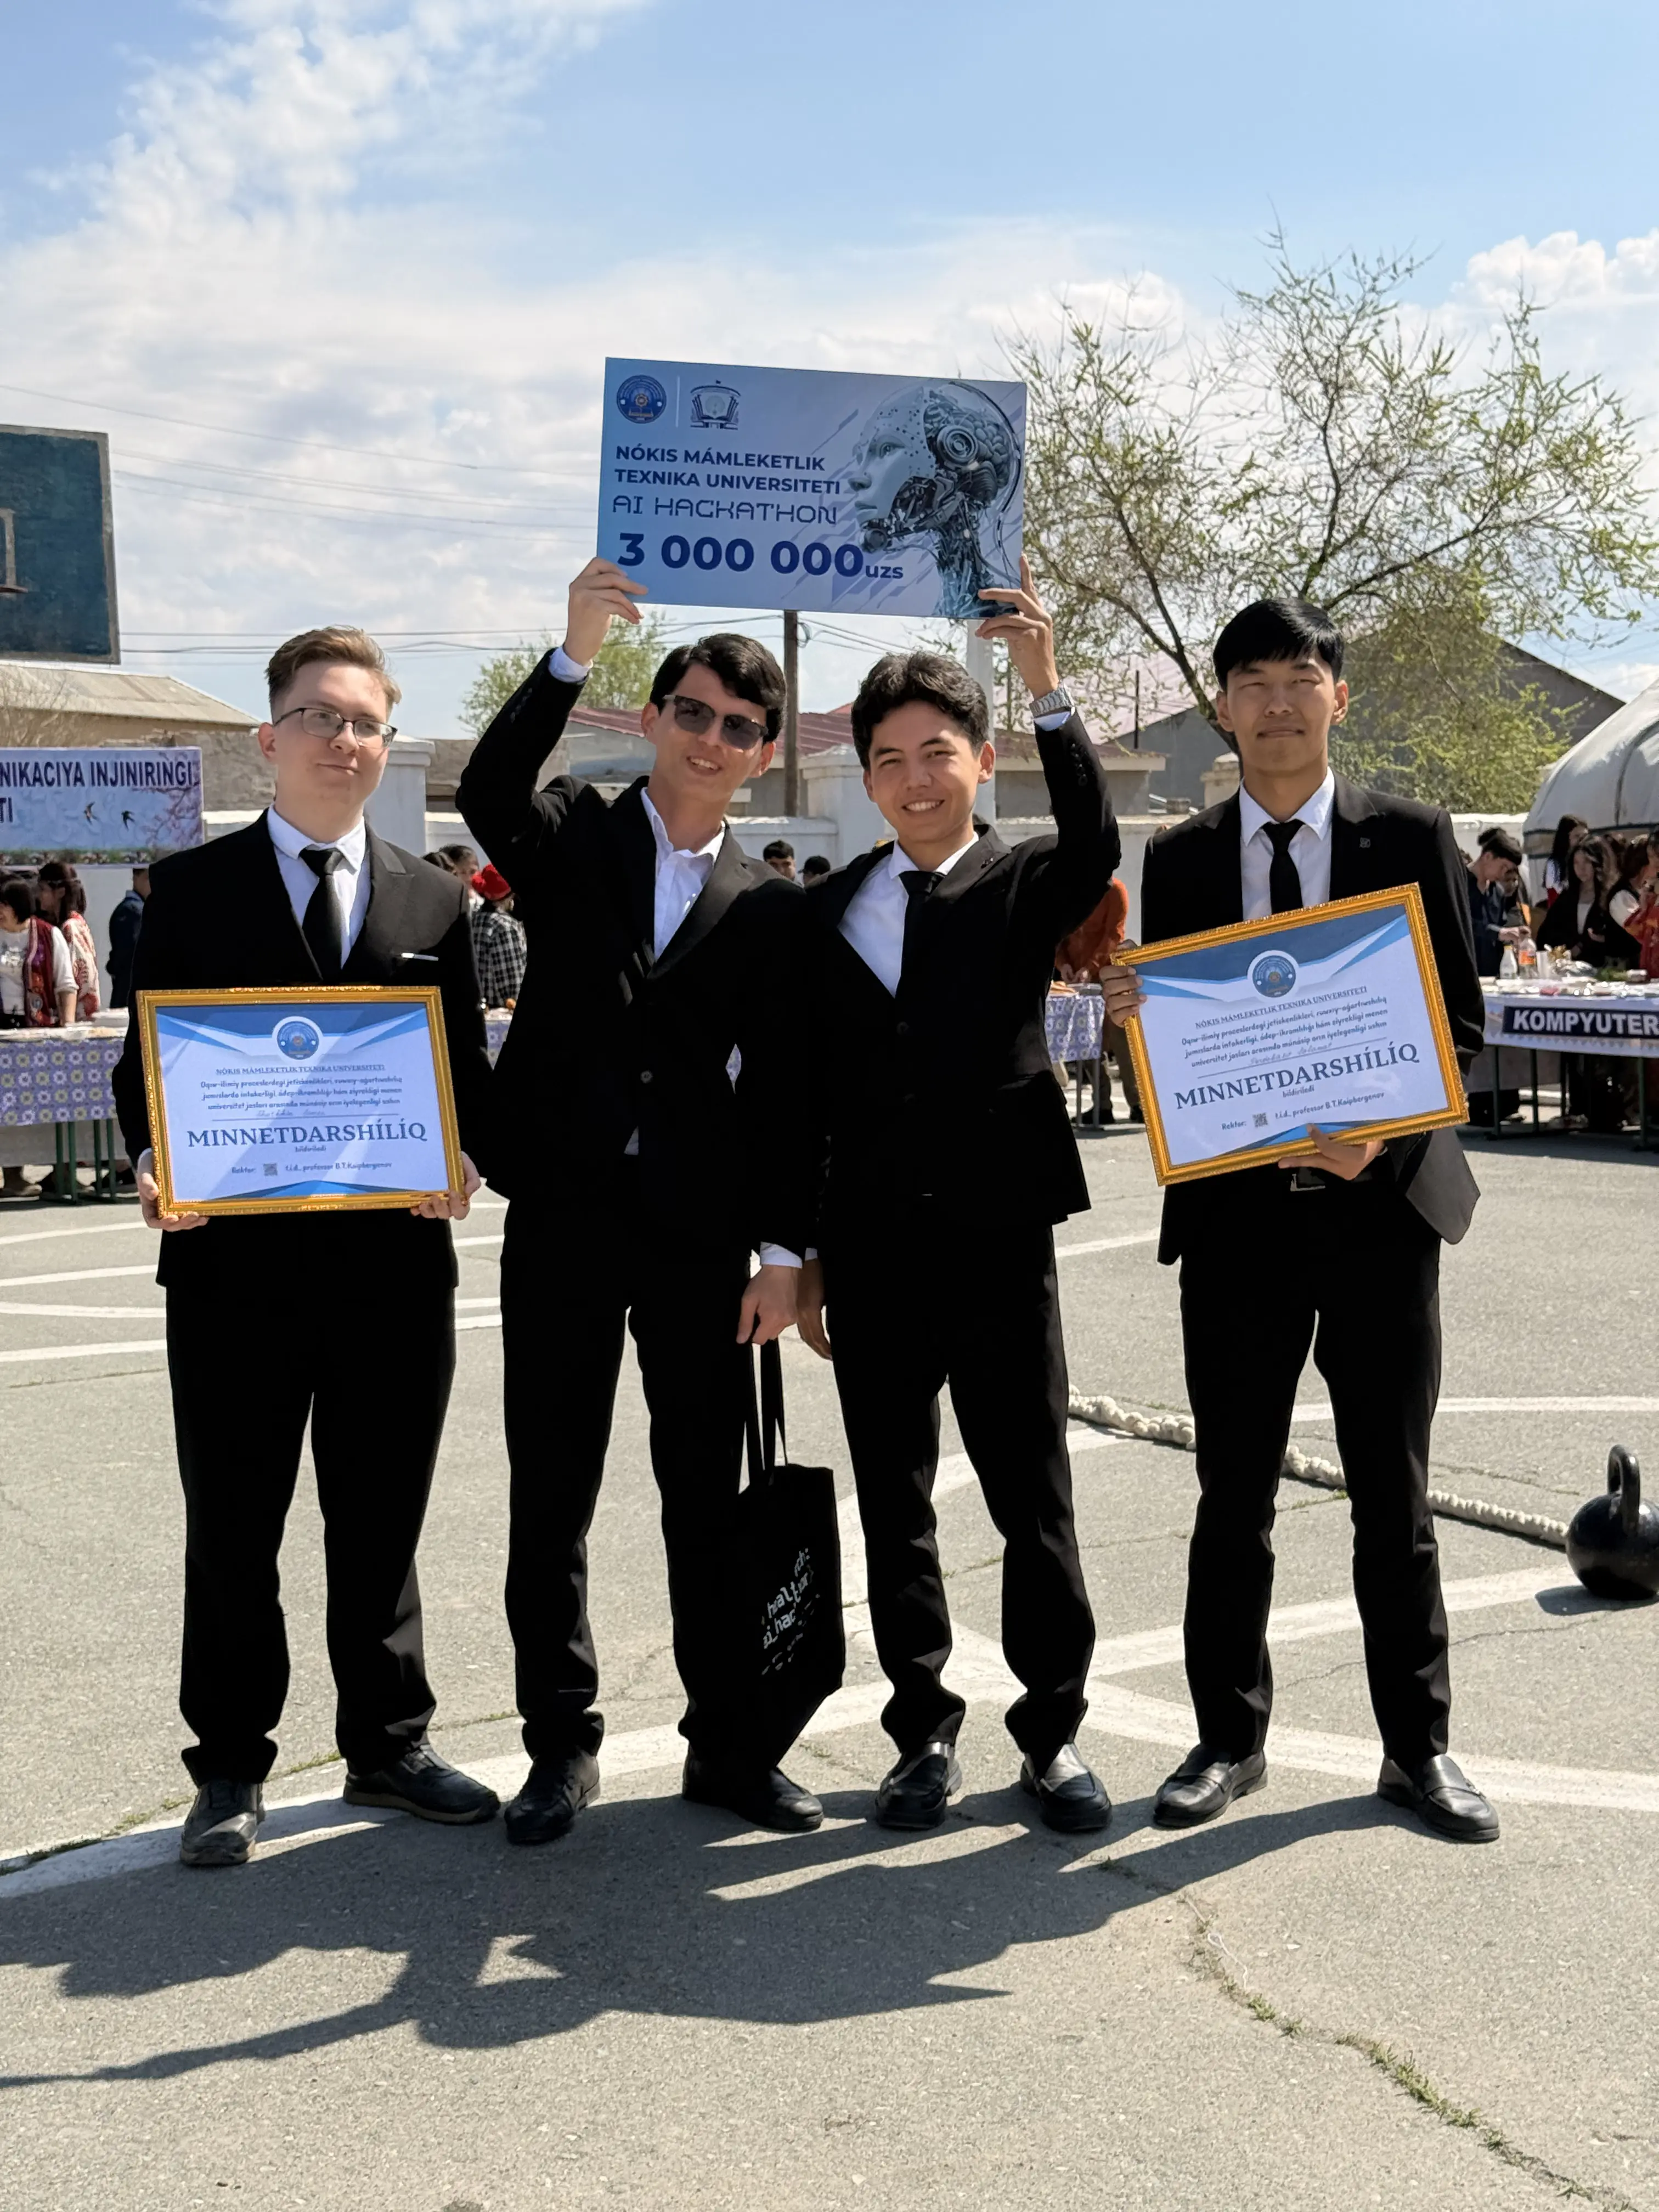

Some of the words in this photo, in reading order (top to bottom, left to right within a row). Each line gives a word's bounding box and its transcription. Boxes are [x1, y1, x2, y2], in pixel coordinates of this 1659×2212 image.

[616, 443, 678, 462] NÓKIS
[683, 447, 825, 471] MÁMLEKETLIK
[614, 469, 700, 487] TEXNIKA
[707, 474, 839, 494] UNIVERSITETI
[613, 495, 643, 514] AI
[654, 496, 837, 525] HACKATHON
[617, 533, 645, 566] 3
[661, 535, 754, 572] 000
[771, 540, 864, 577] 000
[0, 761, 85, 787] NIKACIYA
[91, 761, 192, 787] INJINIRINGI
[1195, 1018, 1220, 1029] NÓKIS
[1221, 1006, 1278, 1024] MÁMLEKETLIK
[1277, 998, 1313, 1012] TEXNIKA
[1313, 986, 1367, 1003] UNIVERSITETI
[1513, 1010, 1659, 1035] KOMPYUTER
[1192, 1053, 1229, 1067] universitet
[1175, 1043, 1419, 1109] MINNETDARSHÍLÍQ
[1293, 1105, 1323, 1118] professor
[188, 1119, 427, 1147] MINNETDARSHÍLÍQ
